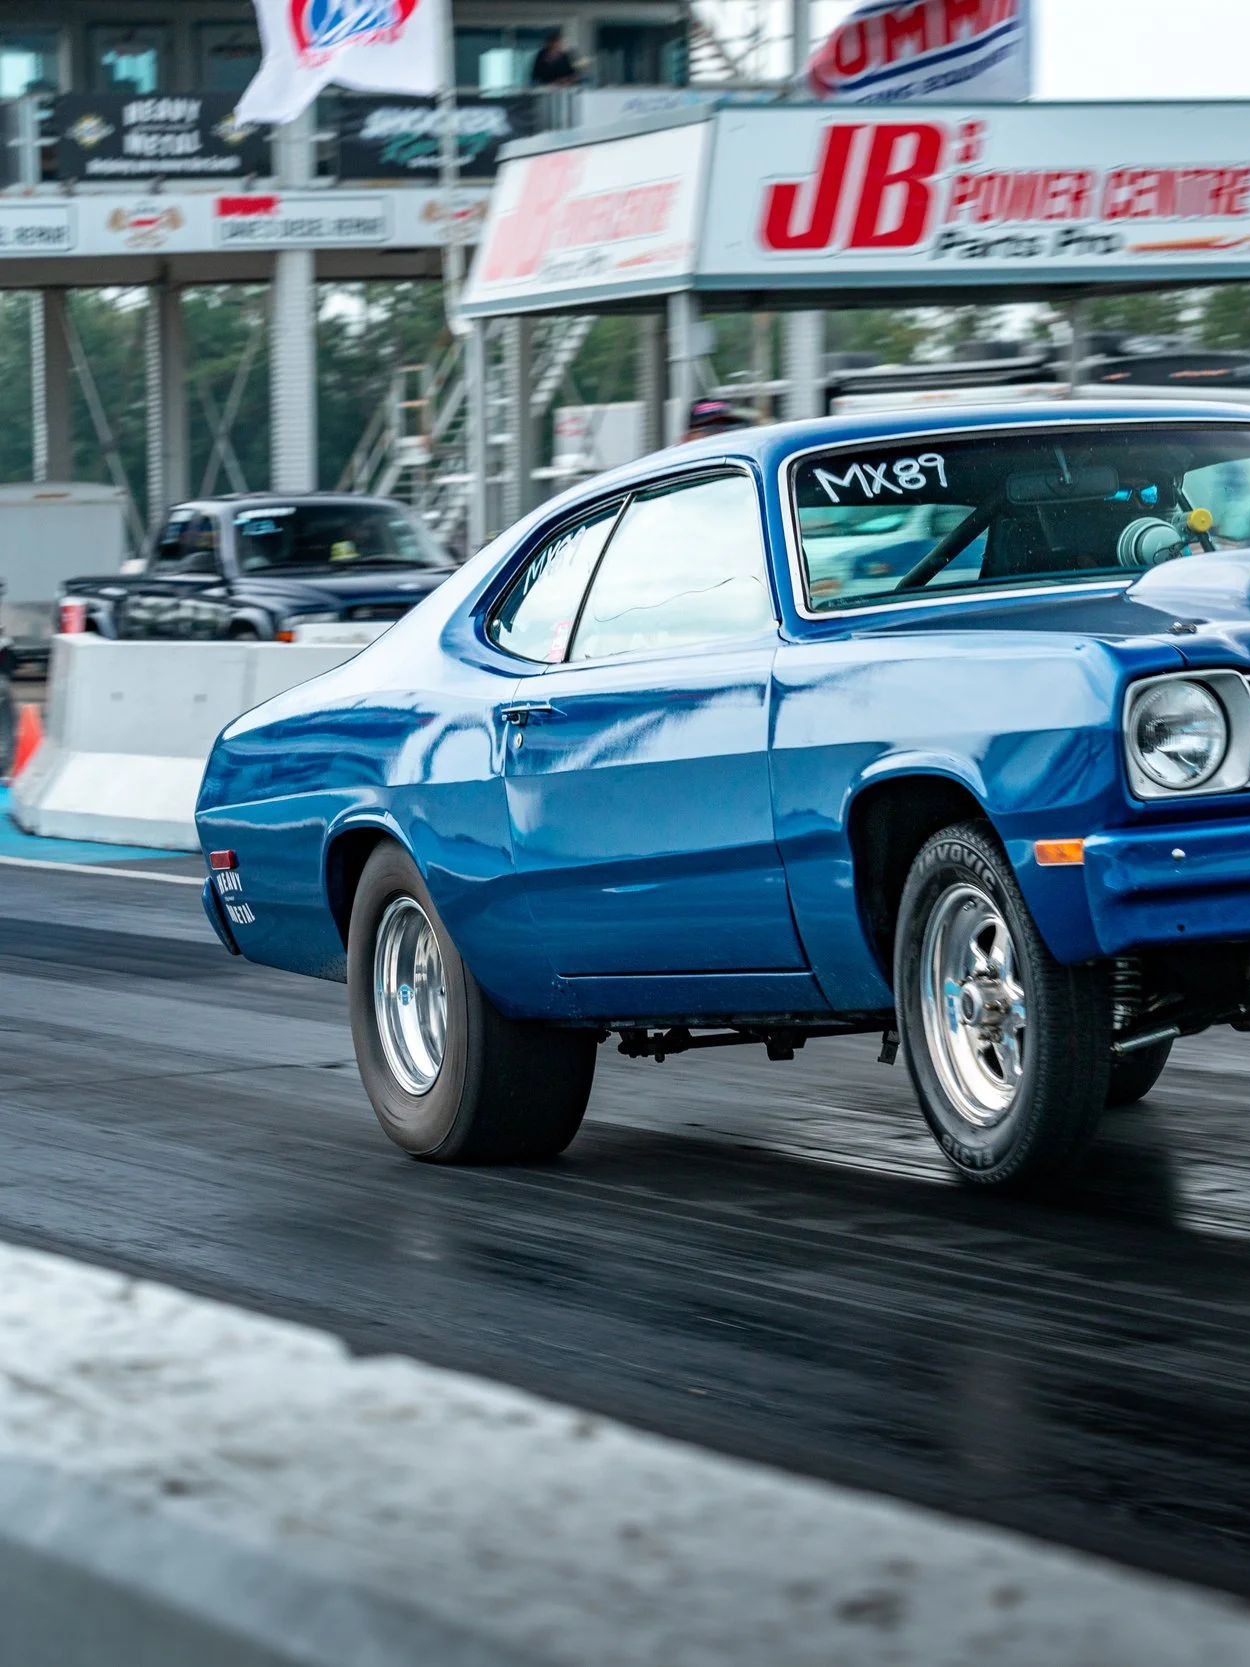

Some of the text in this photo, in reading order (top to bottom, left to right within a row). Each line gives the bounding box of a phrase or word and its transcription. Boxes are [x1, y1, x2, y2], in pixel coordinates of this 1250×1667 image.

[945, 172, 1092, 223] POWER
[928, 226, 1124, 260] Parts Pro
[813, 453, 948, 503] MX89
[216, 871, 243, 895] HEAVY
[917, 843, 997, 892] INVOVIC
[225, 902, 256, 925] METAL
